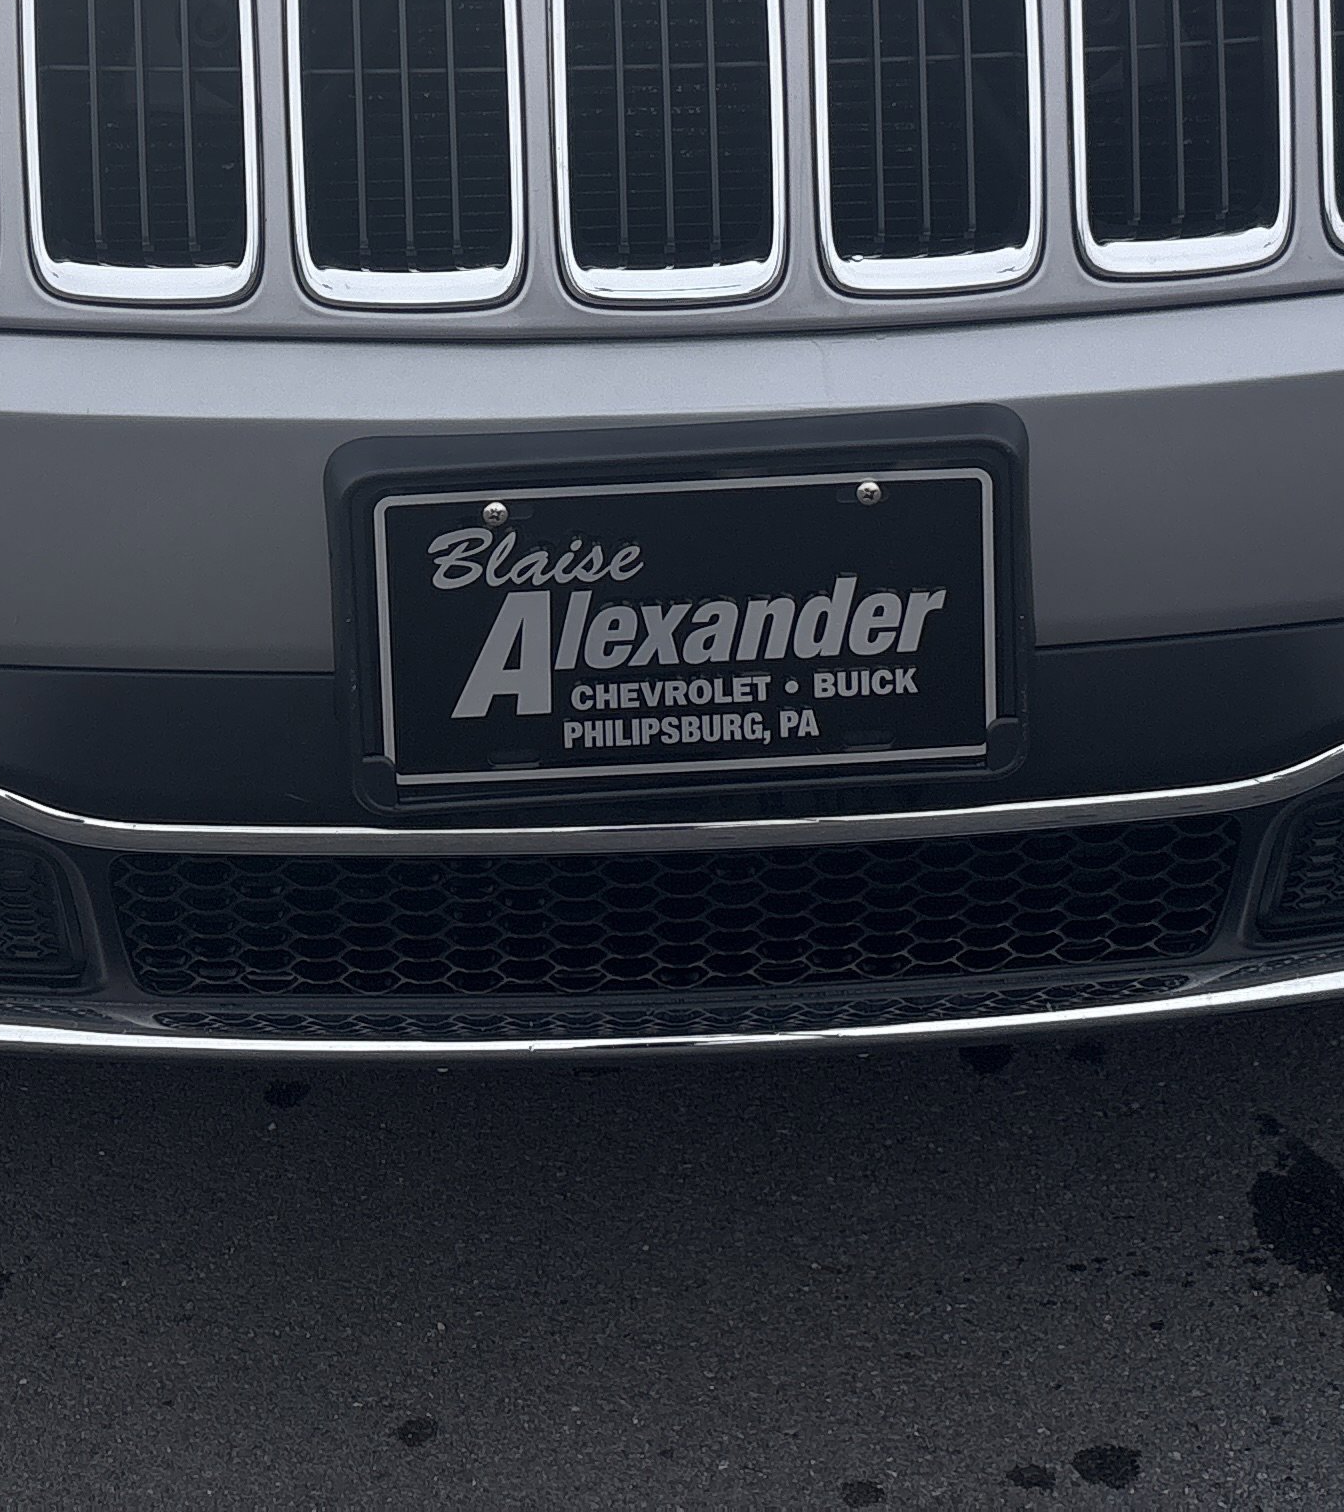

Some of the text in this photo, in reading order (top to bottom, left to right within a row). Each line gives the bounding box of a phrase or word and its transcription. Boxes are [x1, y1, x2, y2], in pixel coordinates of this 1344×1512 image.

[427, 527, 644, 590] Blaise
[450, 577, 947, 719] Alexander
[571, 668, 919, 711] CHEVROLET BUICK
[563, 711, 820, 749] PHILIPSBURG, PA
